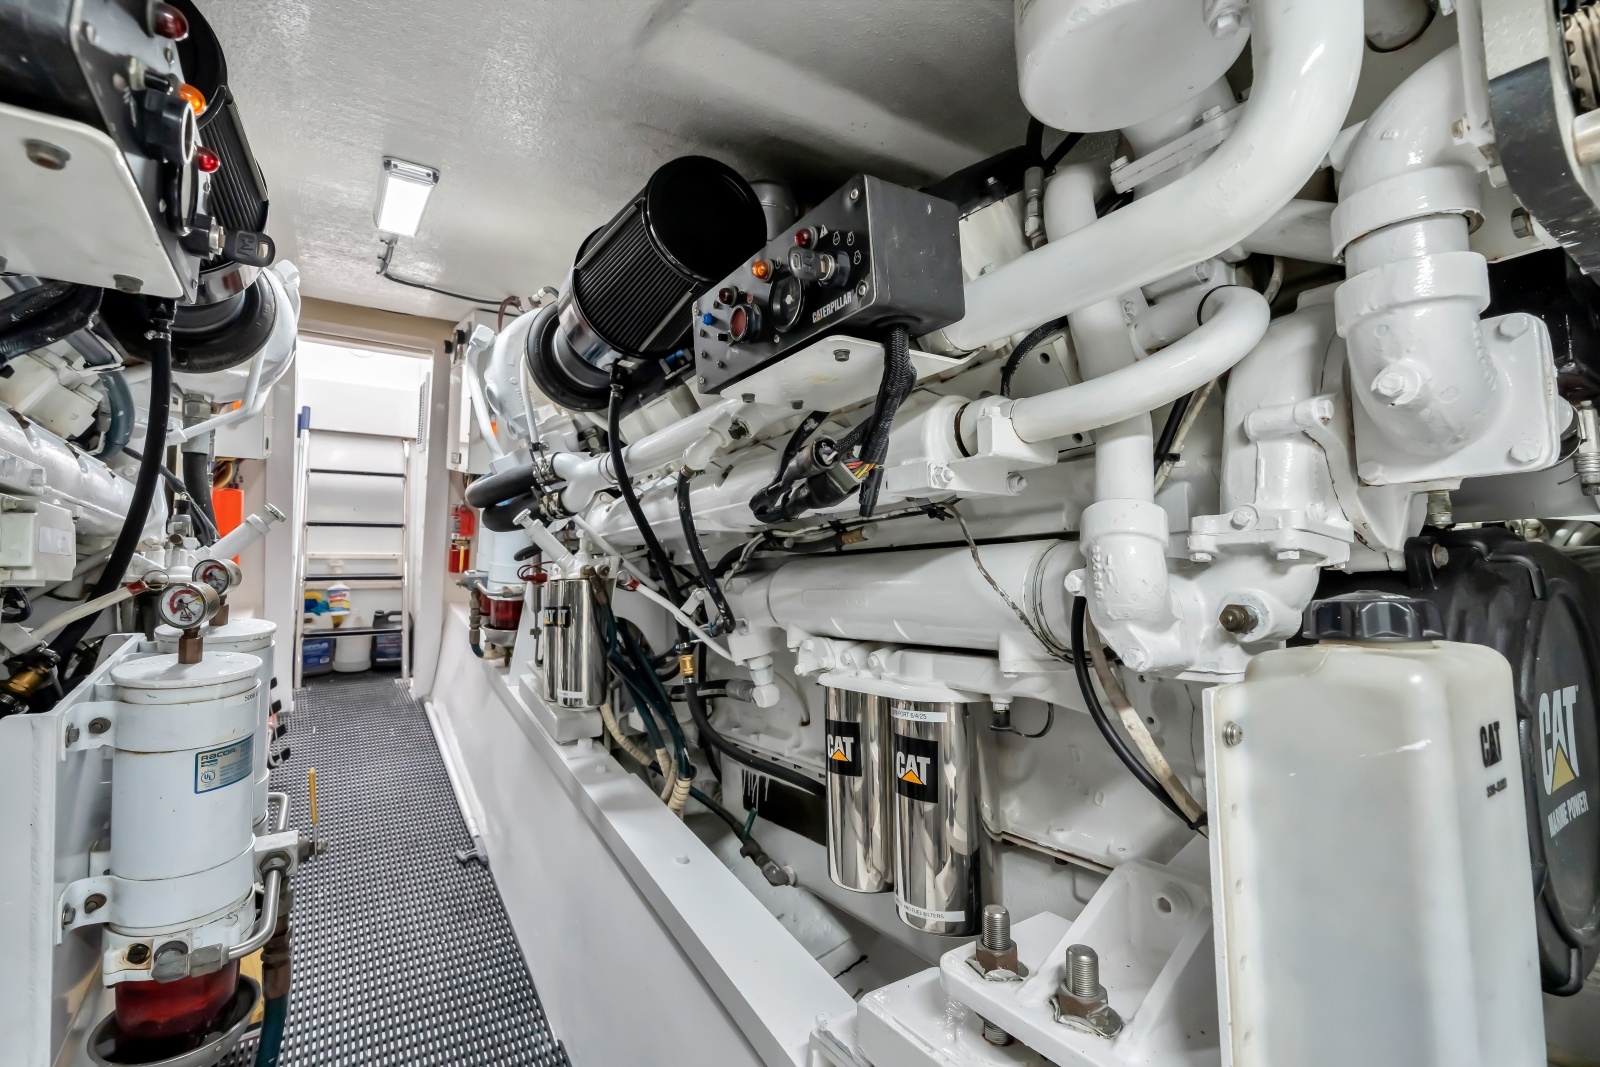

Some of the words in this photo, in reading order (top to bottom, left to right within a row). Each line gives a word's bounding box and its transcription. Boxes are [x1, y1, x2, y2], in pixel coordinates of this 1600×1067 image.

[812, 290, 852, 323] CATERPILLAR
[827, 733, 854, 762] CAT
[1480, 720, 1502, 768] CAT
[1539, 685, 1580, 796] CAT
[896, 751, 931, 786] CAT
[1547, 801, 1570, 839] MARINE
[1566, 790, 1590, 822] POWER
